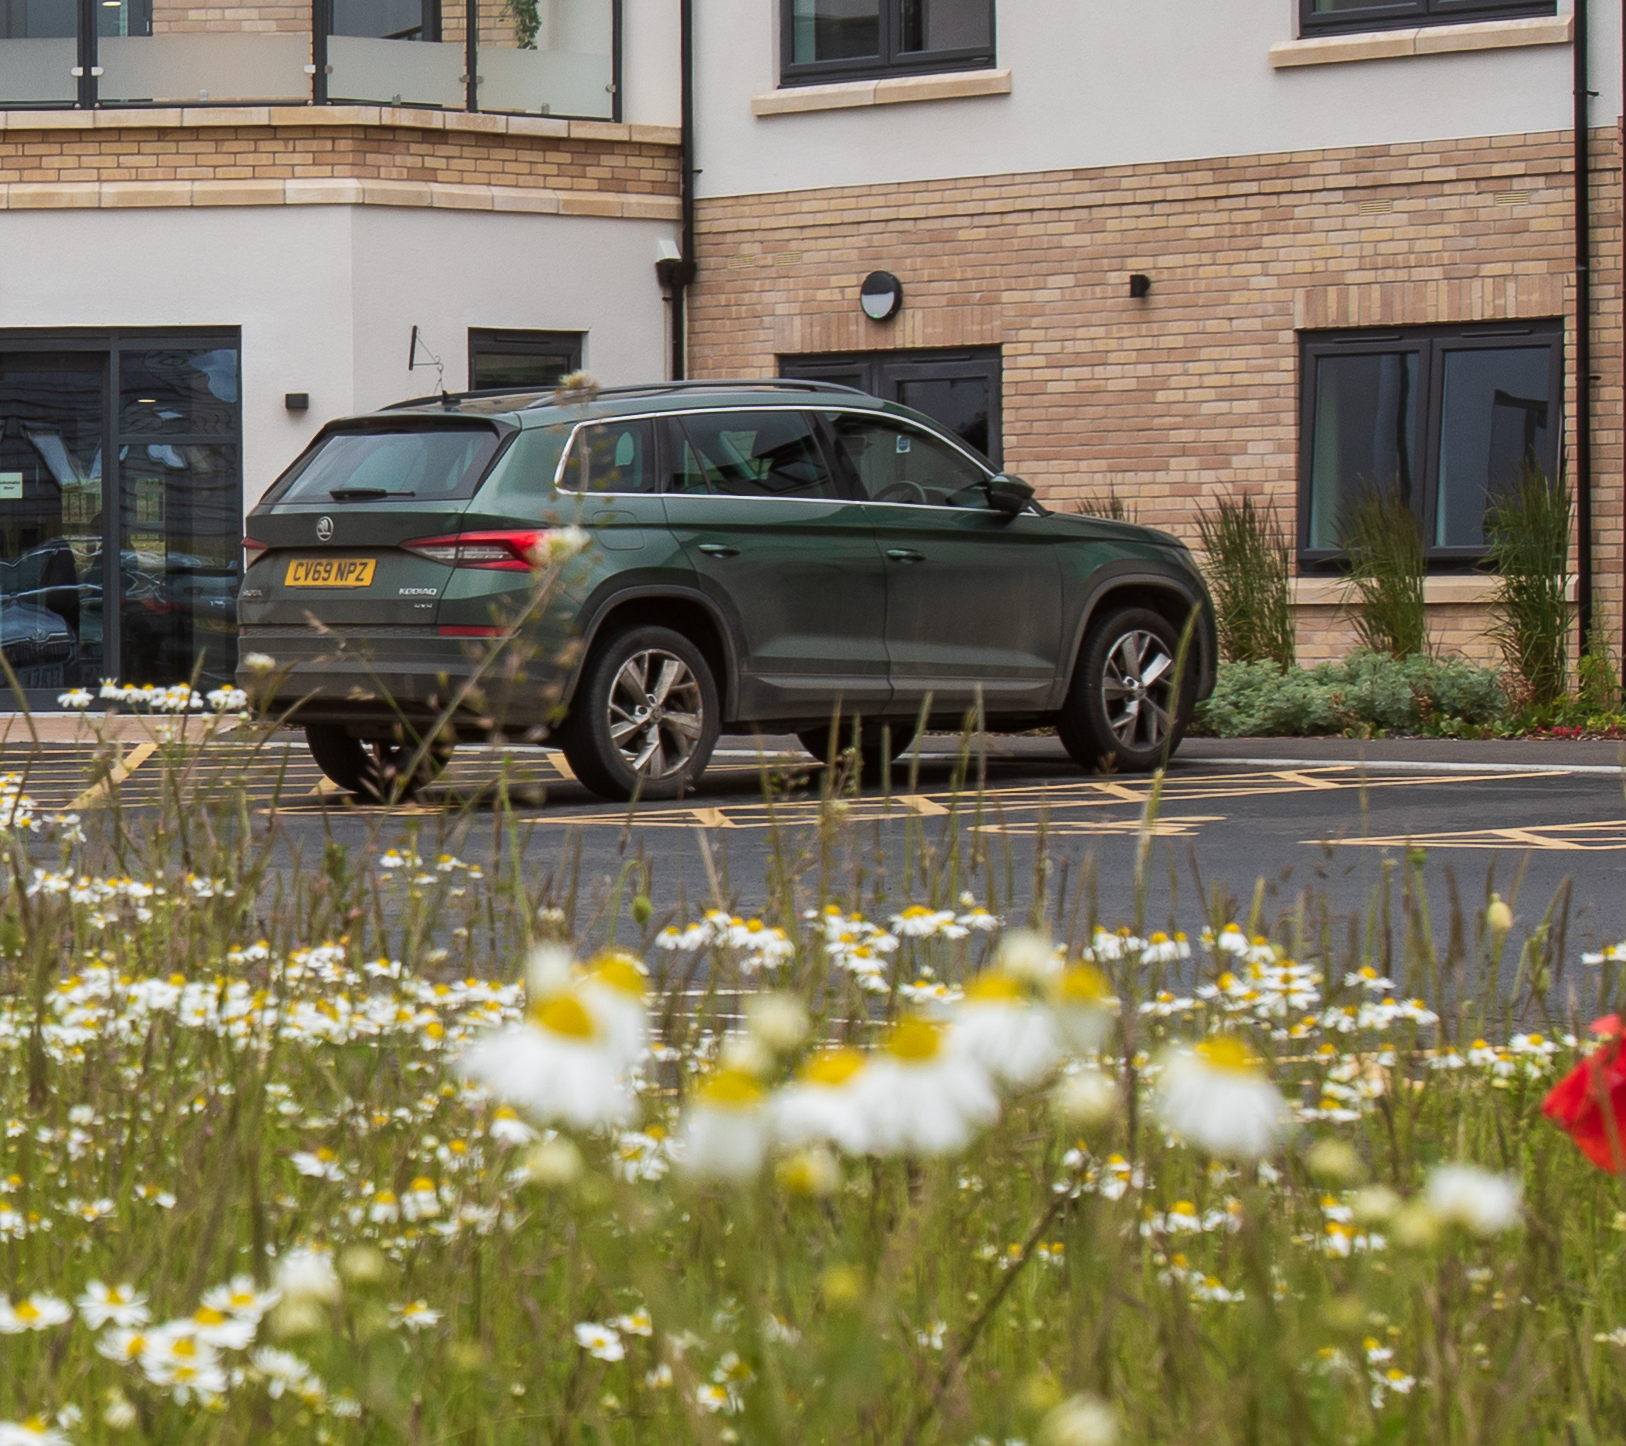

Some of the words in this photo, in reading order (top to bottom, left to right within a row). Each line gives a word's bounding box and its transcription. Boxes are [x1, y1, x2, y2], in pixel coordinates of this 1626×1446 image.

[292, 561, 332, 582] CV69
[334, 561, 369, 582] NPZ
[399, 587, 438, 596] KODIAQ
